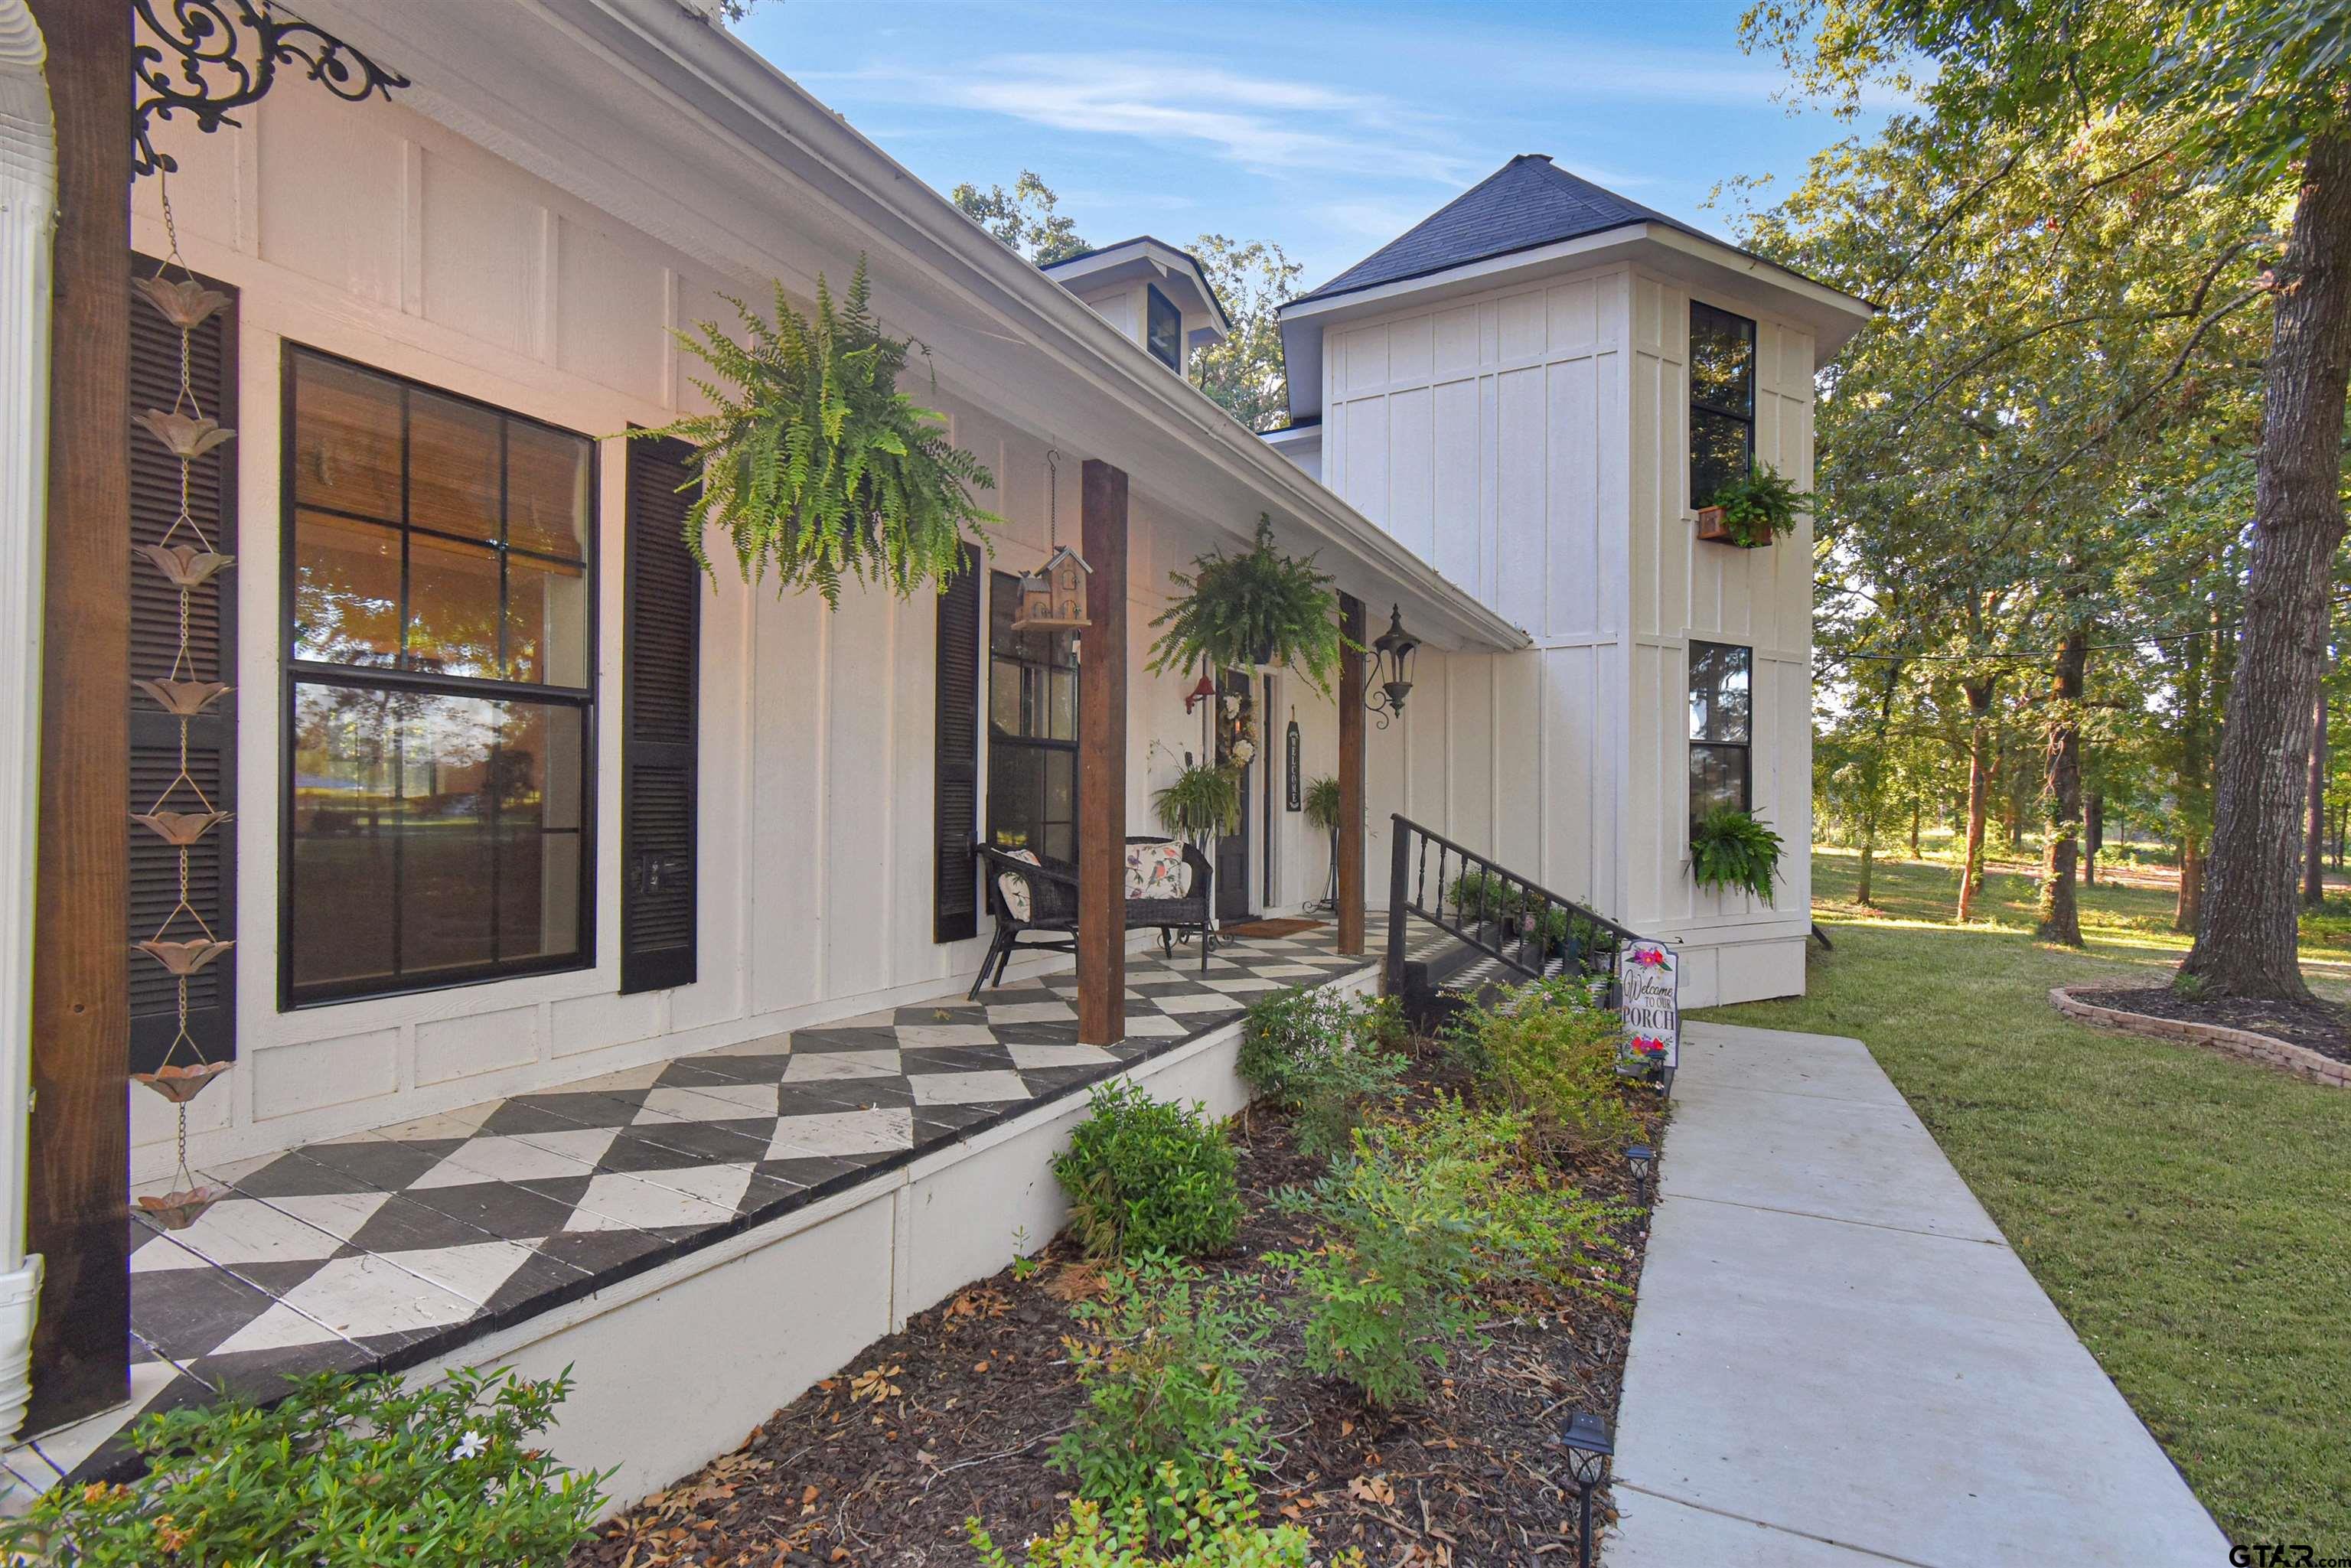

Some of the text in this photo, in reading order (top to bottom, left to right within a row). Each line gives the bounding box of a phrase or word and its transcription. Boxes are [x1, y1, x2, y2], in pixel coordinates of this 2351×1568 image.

[1623, 969, 1673, 1002] Welcome
[1645, 996, 1671, 1009] TO OUR
[1622, 1007, 1674, 1031] PORCH
